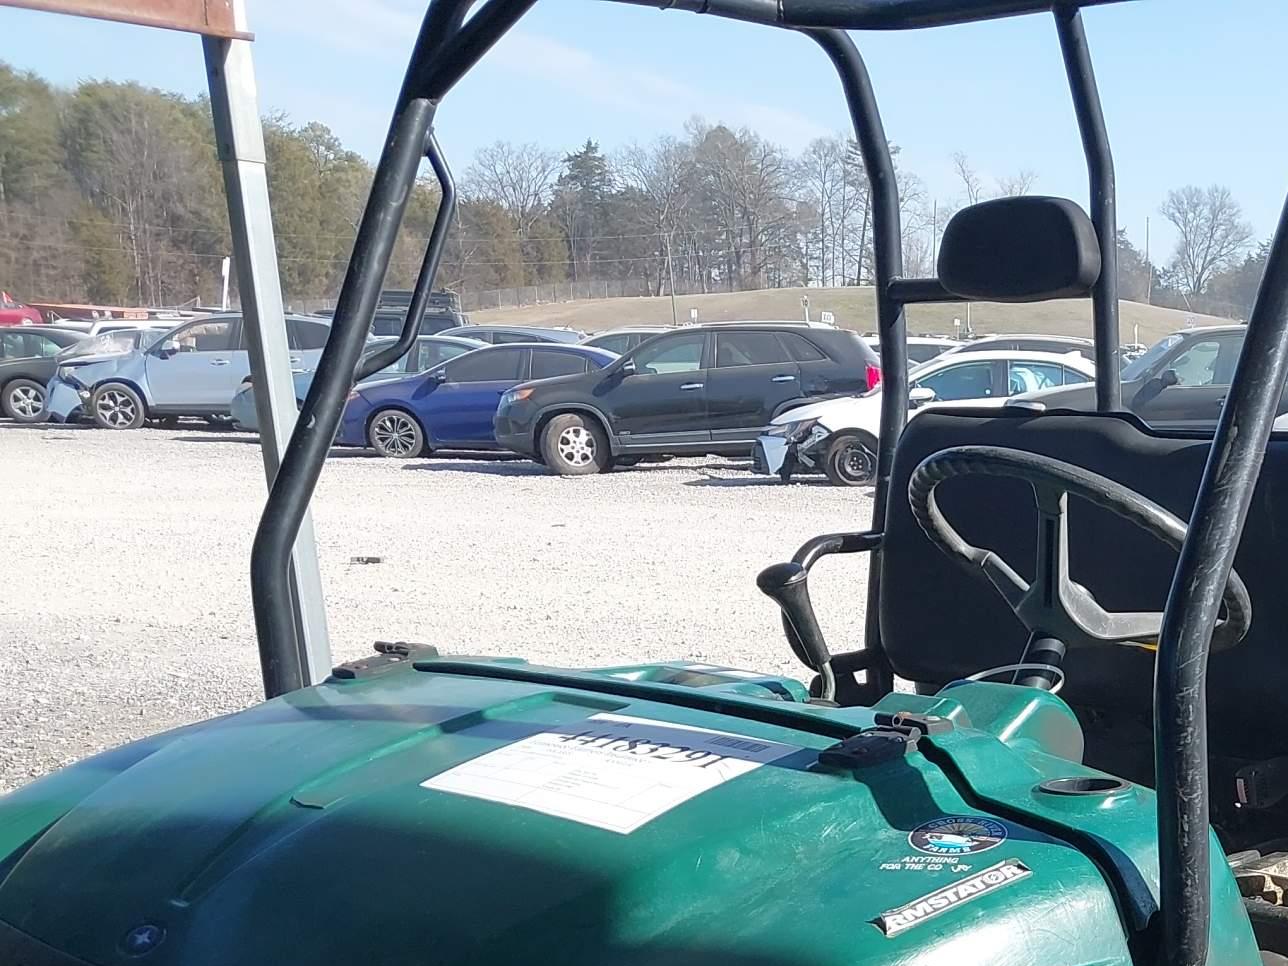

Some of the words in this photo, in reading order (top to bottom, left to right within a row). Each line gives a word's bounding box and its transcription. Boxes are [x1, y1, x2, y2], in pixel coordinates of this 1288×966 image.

[558, 730, 728, 769] 44183291
[900, 855, 959, 864] ANYTHING
[879, 863, 902, 871] FOR
[903, 863, 925, 871] THE
